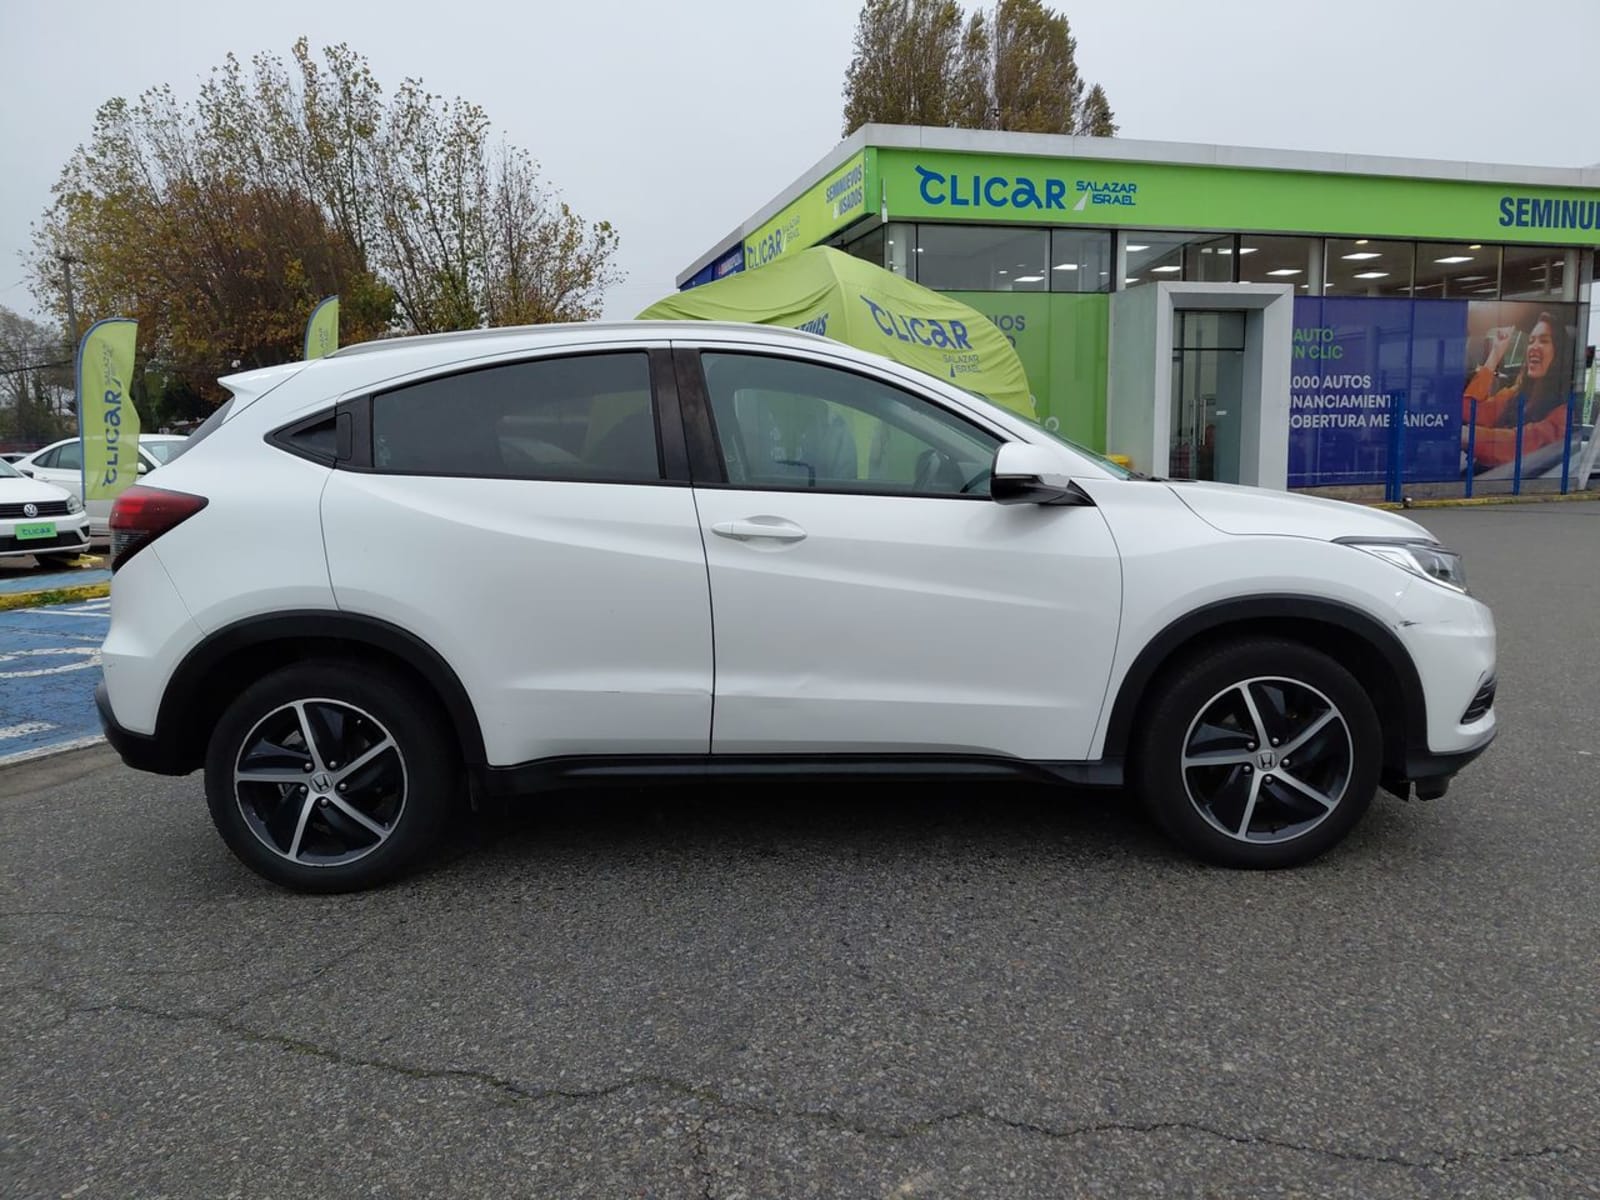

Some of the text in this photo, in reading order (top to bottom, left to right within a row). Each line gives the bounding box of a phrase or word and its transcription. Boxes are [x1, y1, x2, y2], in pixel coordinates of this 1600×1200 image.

[1076, 180, 1137, 194] SALAZAR
[1092, 193, 1137, 206] ISRAEL
[1293, 327, 1335, 343] AUTO
[1308, 344, 1344, 360] CLIC
[1322, 374, 1372, 389] AUTOS
[1289, 410, 1449, 429] OBERTURA MEÁNICA
